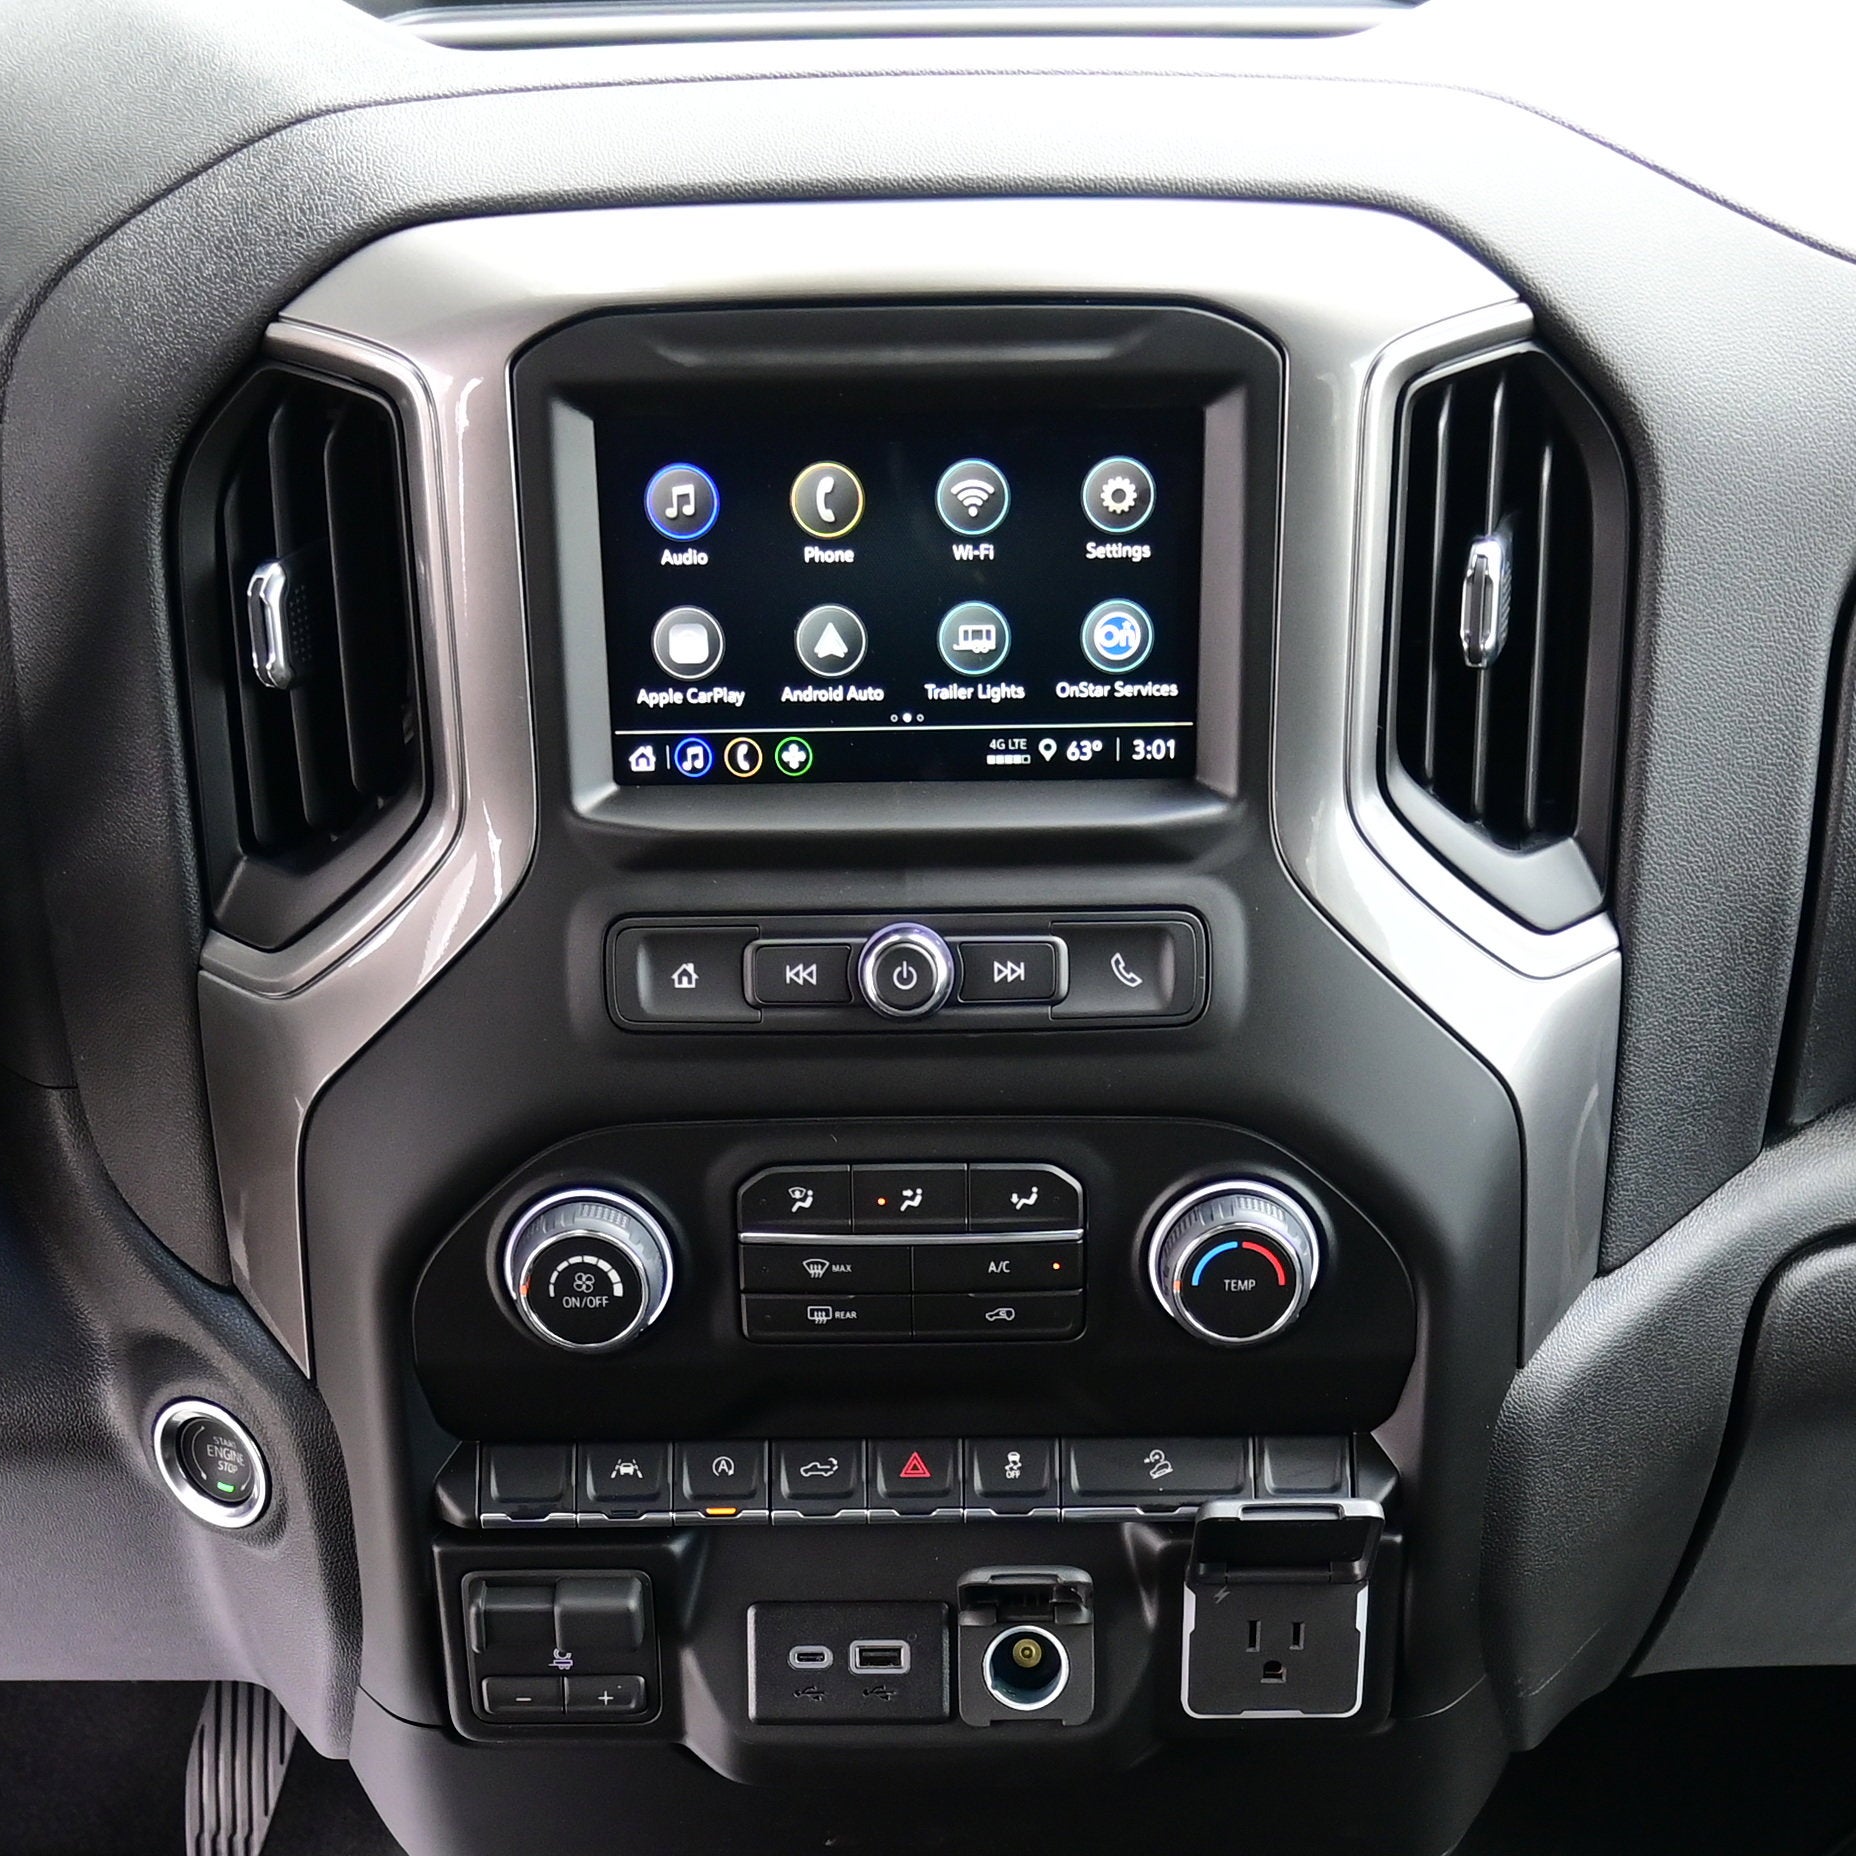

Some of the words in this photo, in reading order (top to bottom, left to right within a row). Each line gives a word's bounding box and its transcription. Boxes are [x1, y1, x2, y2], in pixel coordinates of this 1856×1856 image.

[661, 548, 708, 565] Audio
[804, 546, 854, 563] Phone
[953, 544, 994, 560] Wi-Fi
[1086, 542, 1151, 562] Settings
[637, 688, 683, 708] Apple
[687, 687, 745, 706] CarPlay
[781, 685, 843, 702] Android
[847, 686, 884, 701] Auto
[924, 683, 974, 699] Trailer
[978, 683, 1025, 703] Lights
[1056, 682, 1111, 698] OnStar
[1114, 681, 1178, 697] Services
[989, 738, 1006, 750] 4G
[1008, 738, 1027, 750] LTE
[1132, 739, 1175, 760] 3:01
[831, 1264, 852, 1273] MAX
[988, 1260, 1010, 1273] A/C
[1223, 1279, 1256, 1292] TEMP
[562, 1295, 609, 1309] ON/OFF
[834, 1310, 857, 1320] REAR
[207, 1444, 245, 1466] ENGINE
[217, 1460, 239, 1474] STOP
[1004, 1469, 1022, 1480] OFF
